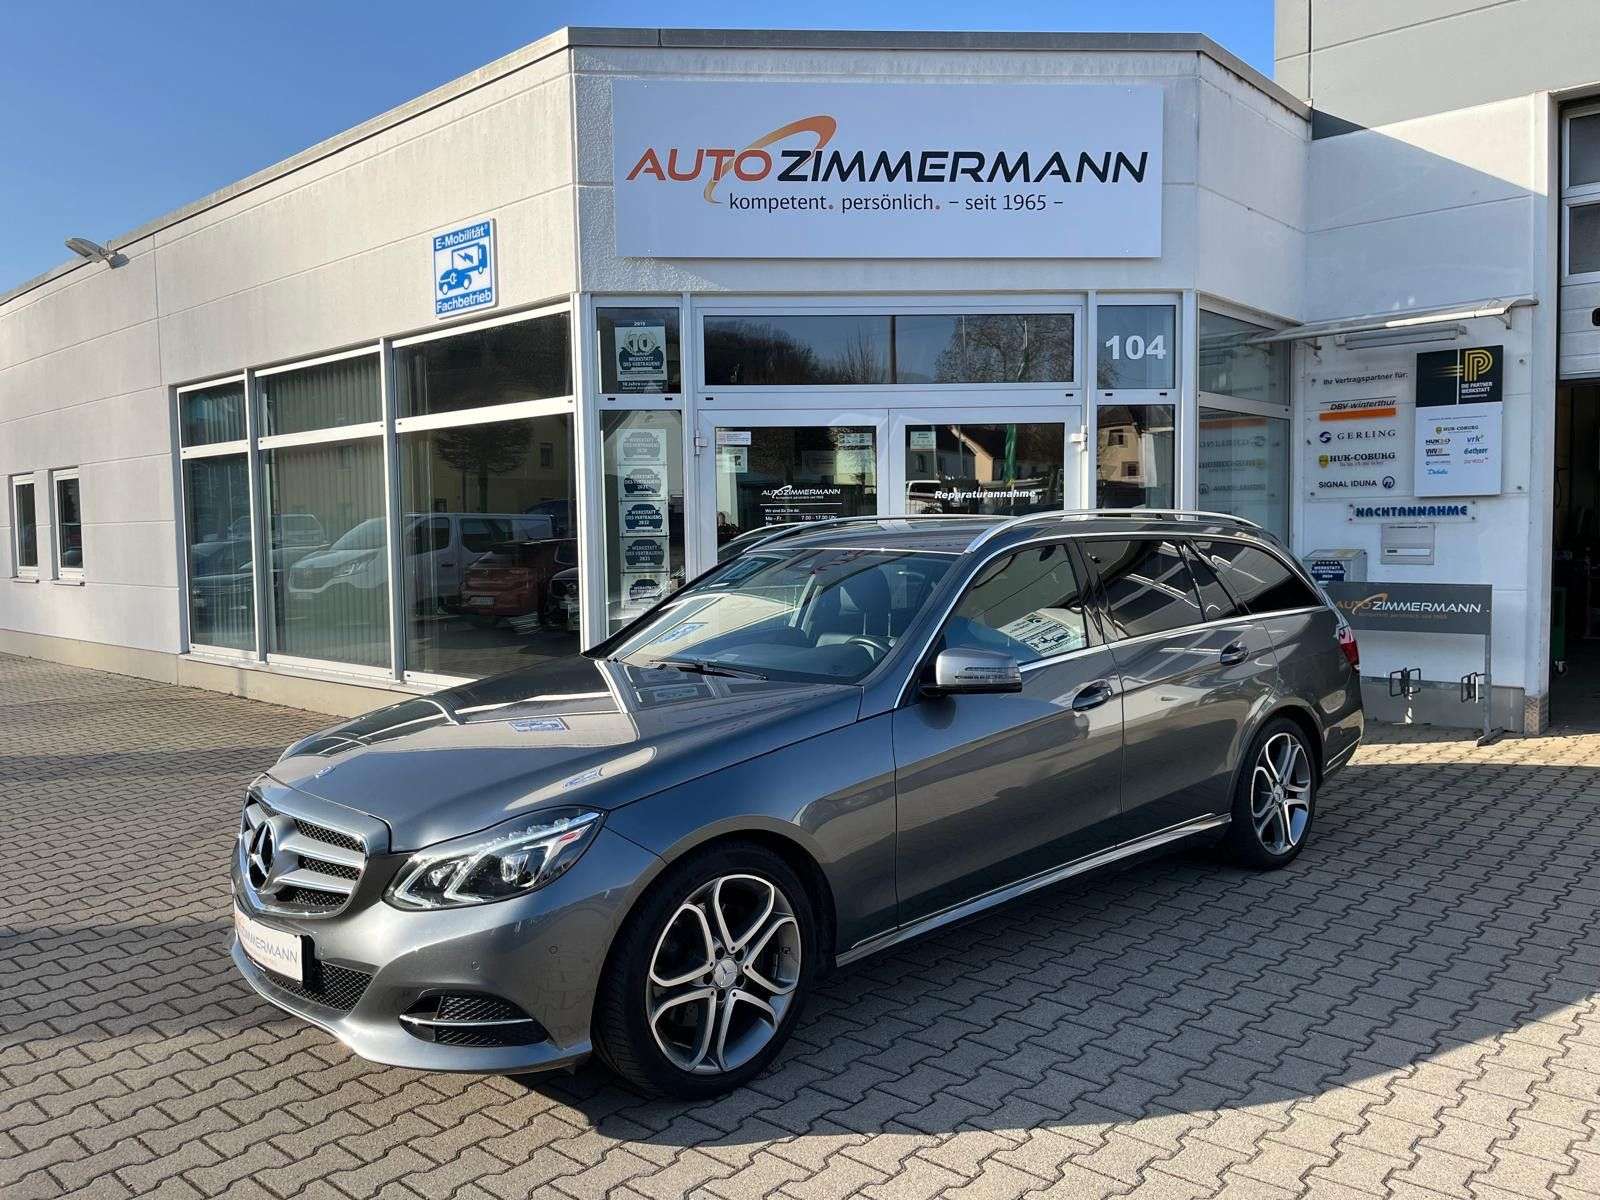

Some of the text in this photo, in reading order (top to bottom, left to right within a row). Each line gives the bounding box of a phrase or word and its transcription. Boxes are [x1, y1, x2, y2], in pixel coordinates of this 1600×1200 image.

[729, 192, 834, 213] kompetent.
[842, 192, 941, 213] persönlich.
[965, 192, 997, 211] seit
[1003, 192, 1047, 211] 1965
[436, 289, 492, 313] Fachbetrieb
[1105, 335, 1166, 360] 104
[1334, 373, 1393, 384] Vertragspartner
[1337, 429, 1396, 440] GERLING
[1318, 479, 1378, 489] SIGNAL IDUNA
[934, 489, 1036, 501] Reparaturannahme
[1355, 505, 1468, 518] NACHTANNAHME
[1372, 600, 1482, 614] ZIMMERMANN
